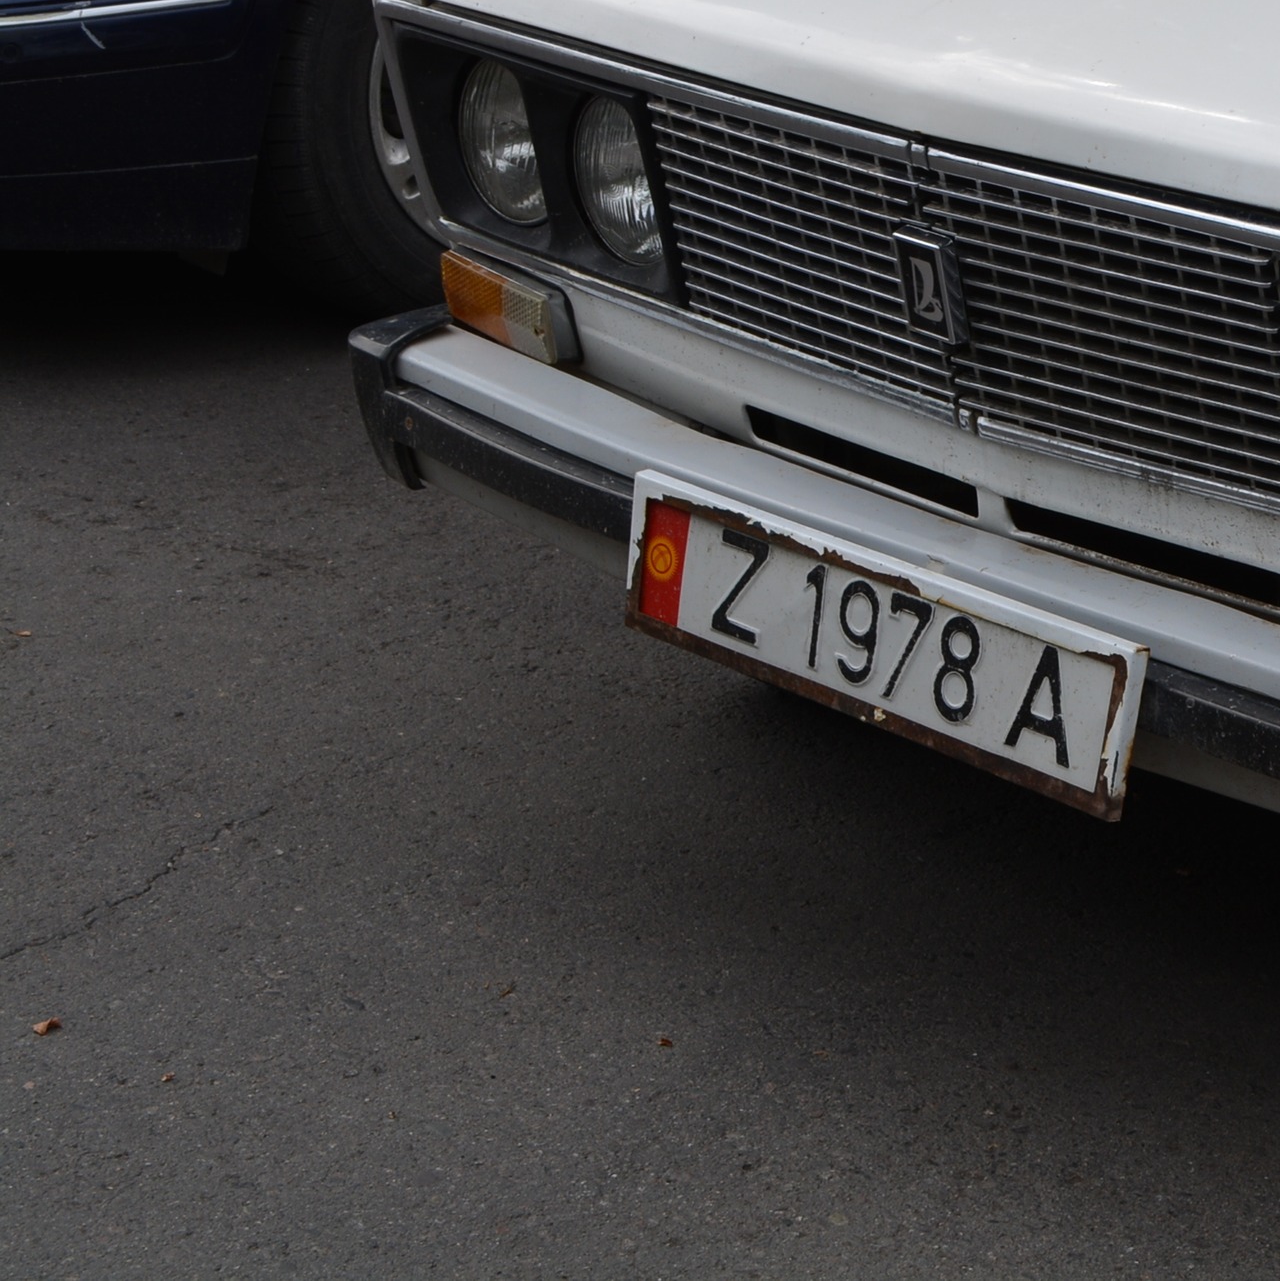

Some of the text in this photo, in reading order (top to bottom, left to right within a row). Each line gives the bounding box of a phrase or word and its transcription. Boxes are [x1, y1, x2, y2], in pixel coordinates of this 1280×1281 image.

[711, 528, 1070, 769] Z 1978 A
